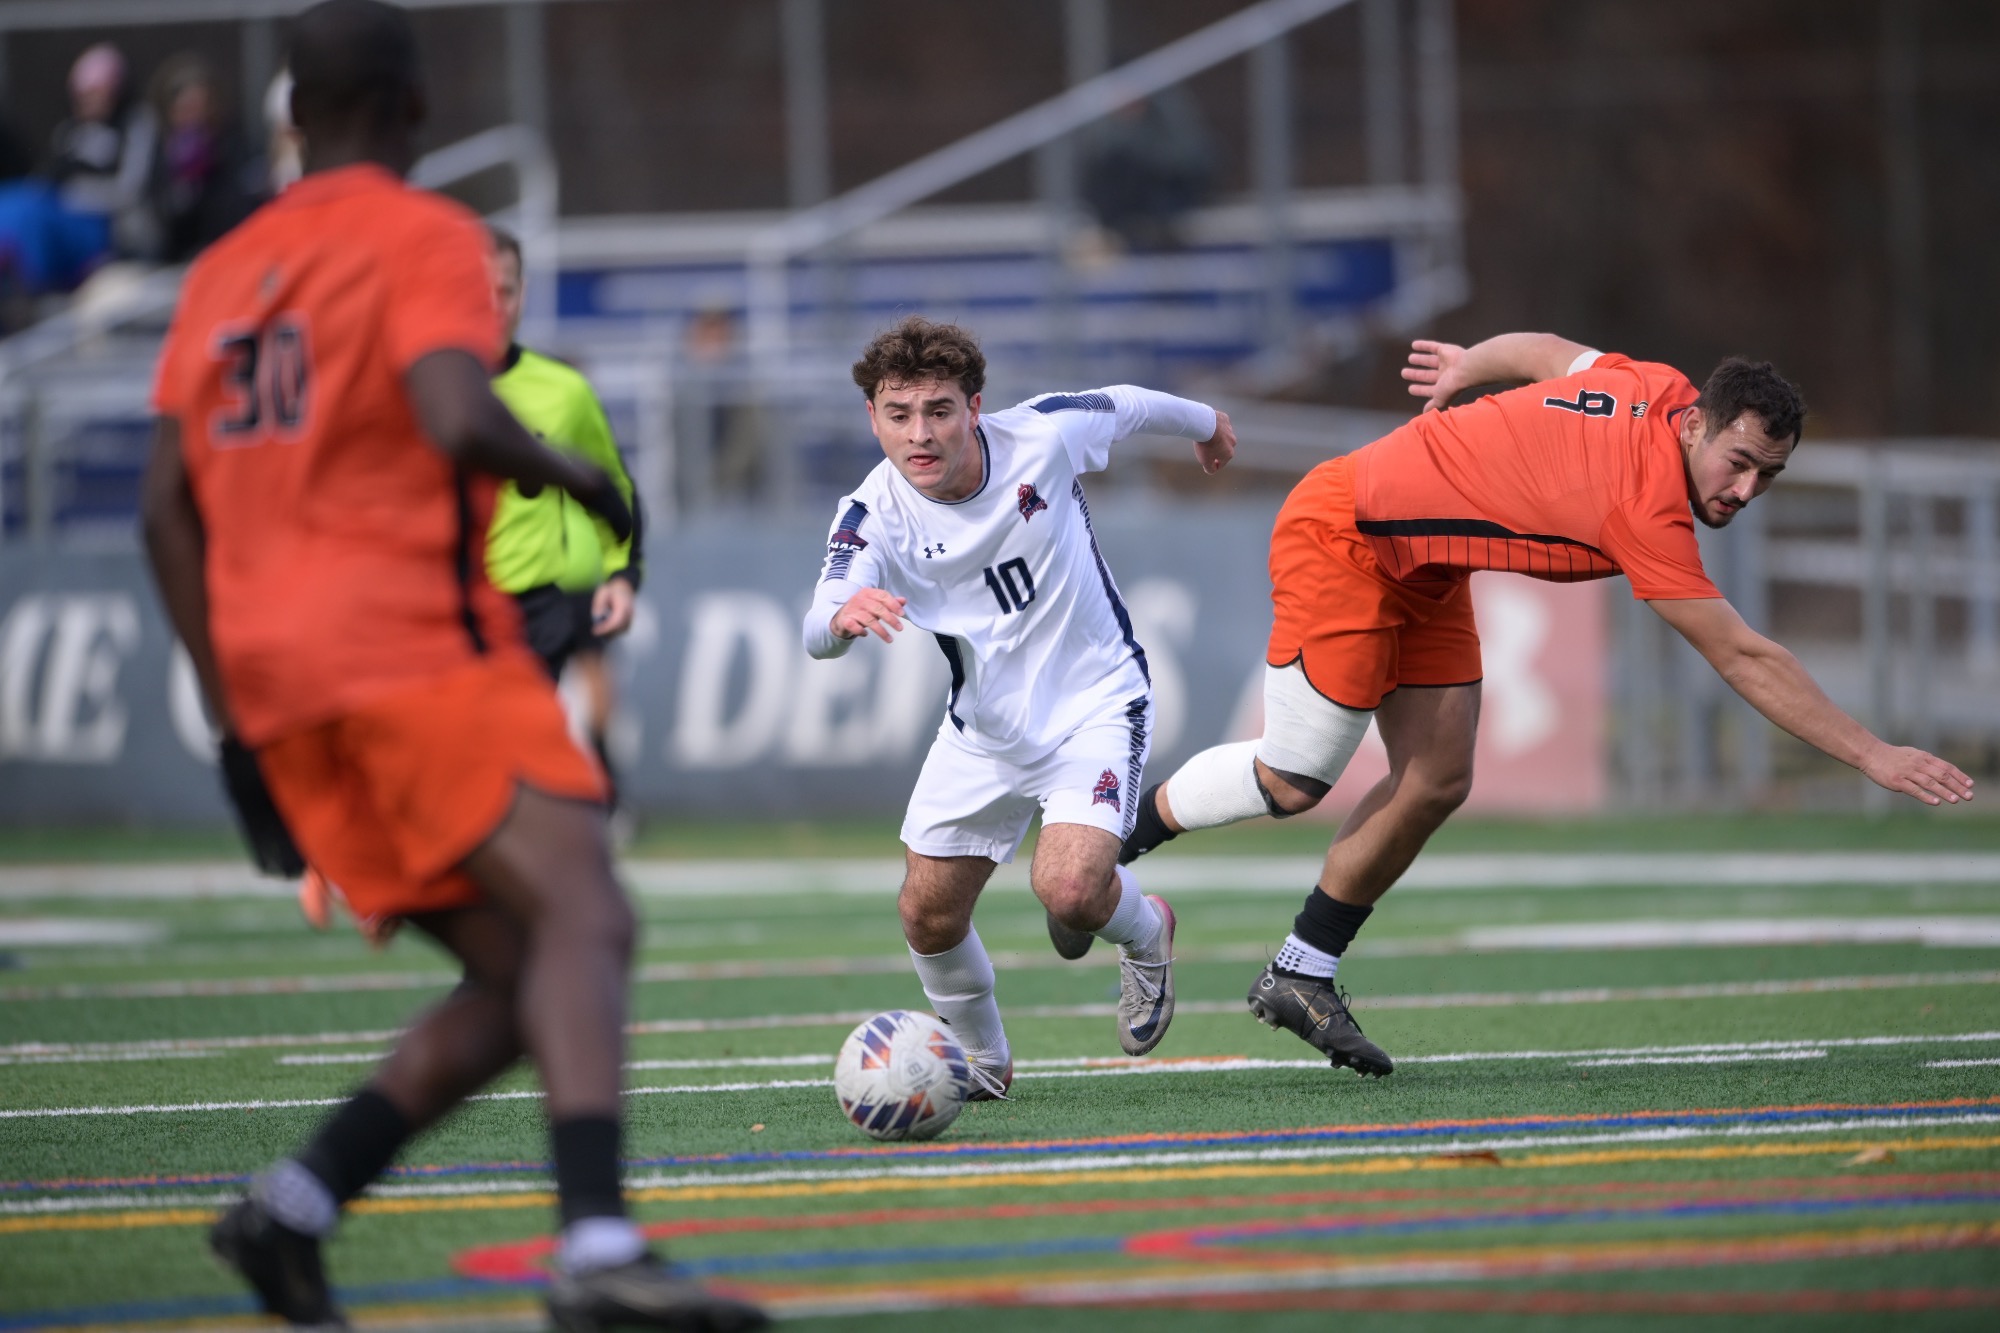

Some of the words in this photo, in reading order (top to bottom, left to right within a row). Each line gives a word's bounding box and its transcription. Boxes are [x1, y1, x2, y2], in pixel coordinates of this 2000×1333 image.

[209, 316, 315, 447] 30
[1543, 388, 1617, 418] 9
[983, 556, 1036, 615] 10
